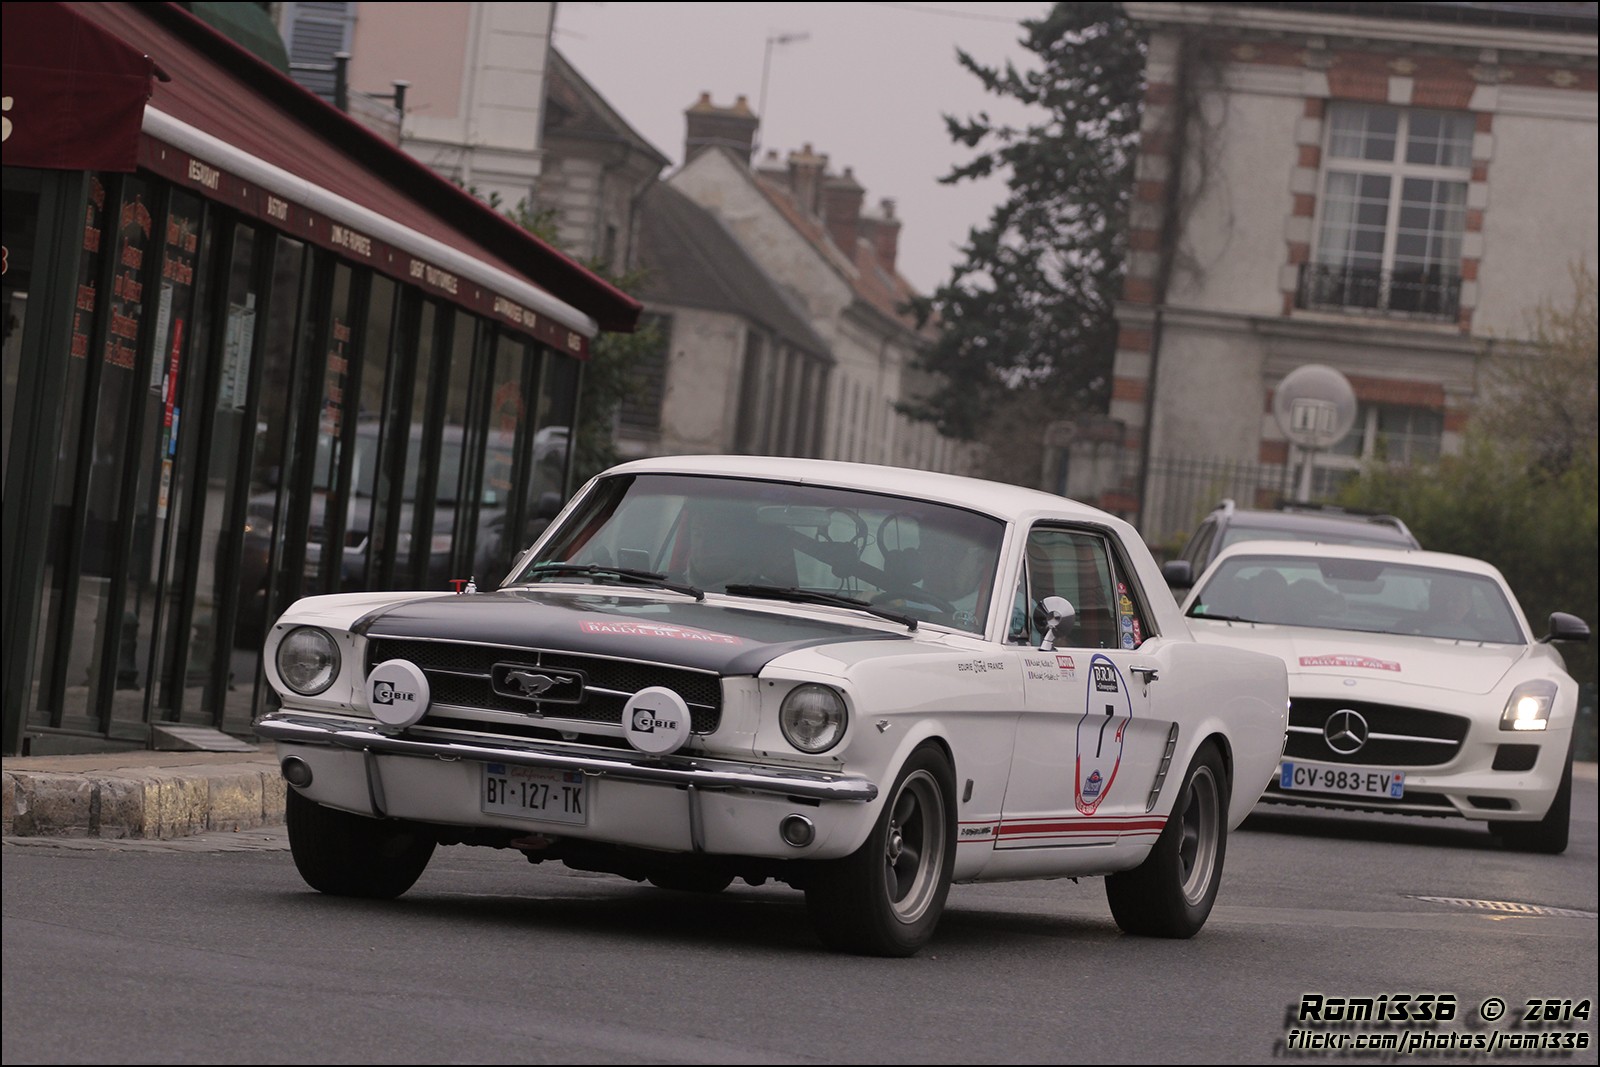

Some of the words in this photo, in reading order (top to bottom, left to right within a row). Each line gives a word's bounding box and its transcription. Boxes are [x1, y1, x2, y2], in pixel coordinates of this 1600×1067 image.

[589, 623, 648, 635] RALLYE
[654, 630, 672, 638] DE
[987, 662, 1004, 670] FRANCE
[1096, 704, 1114, 758] 7
[1294, 767, 1391, 793] CV-983-EV
